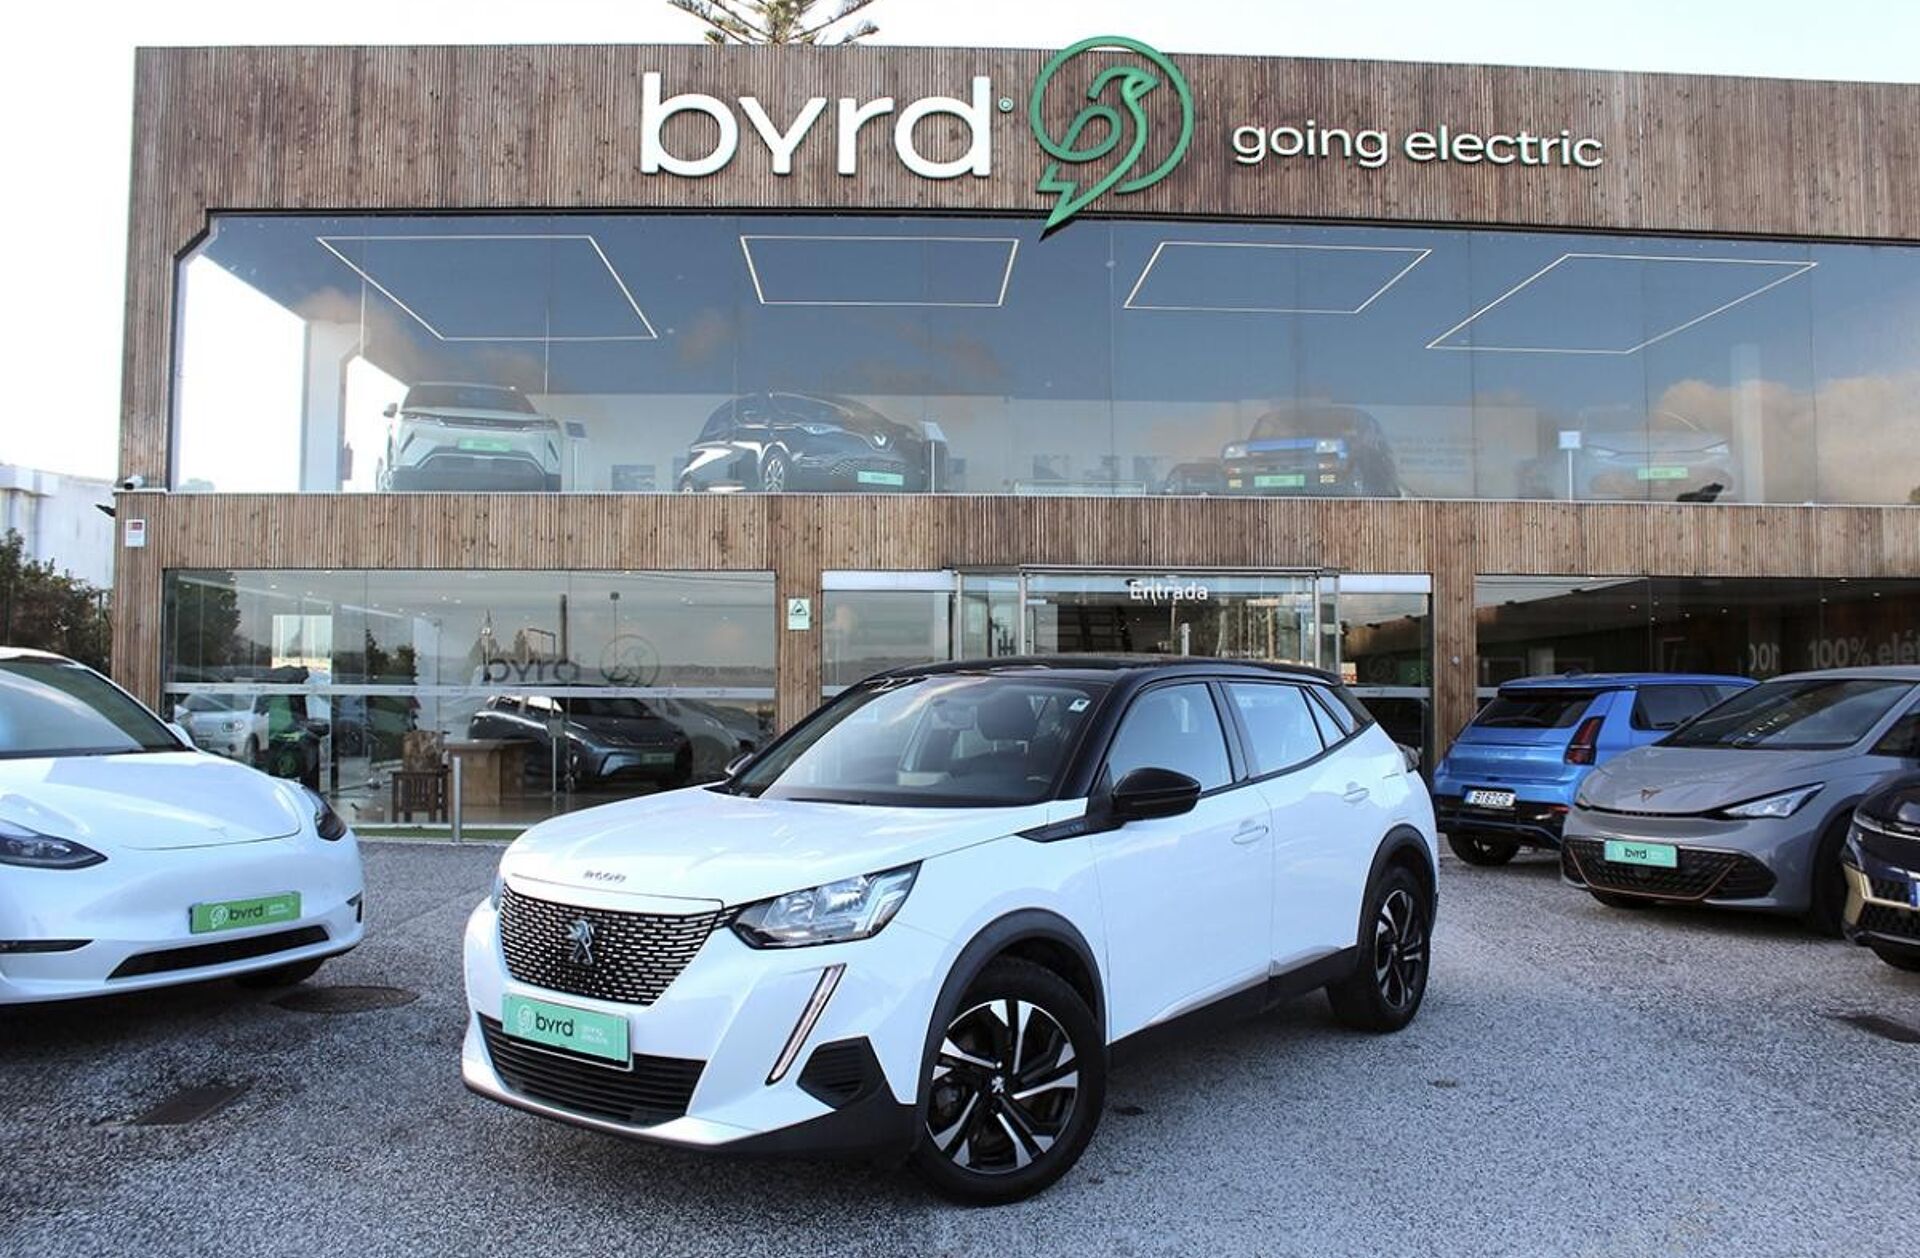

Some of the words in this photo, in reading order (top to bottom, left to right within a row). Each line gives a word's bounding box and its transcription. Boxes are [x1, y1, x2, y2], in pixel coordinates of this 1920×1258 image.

[641, 72, 992, 179] byrd
[1232, 119, 1388, 167] going
[1403, 125, 1603, 168] electric
[1130, 581, 1209, 600] Entrada
[1808, 636, 1872, 669] 100%
[1876, 629, 1920, 667] elé
[229, 904, 263, 920] byrd
[535, 1012, 574, 1037] byrd
